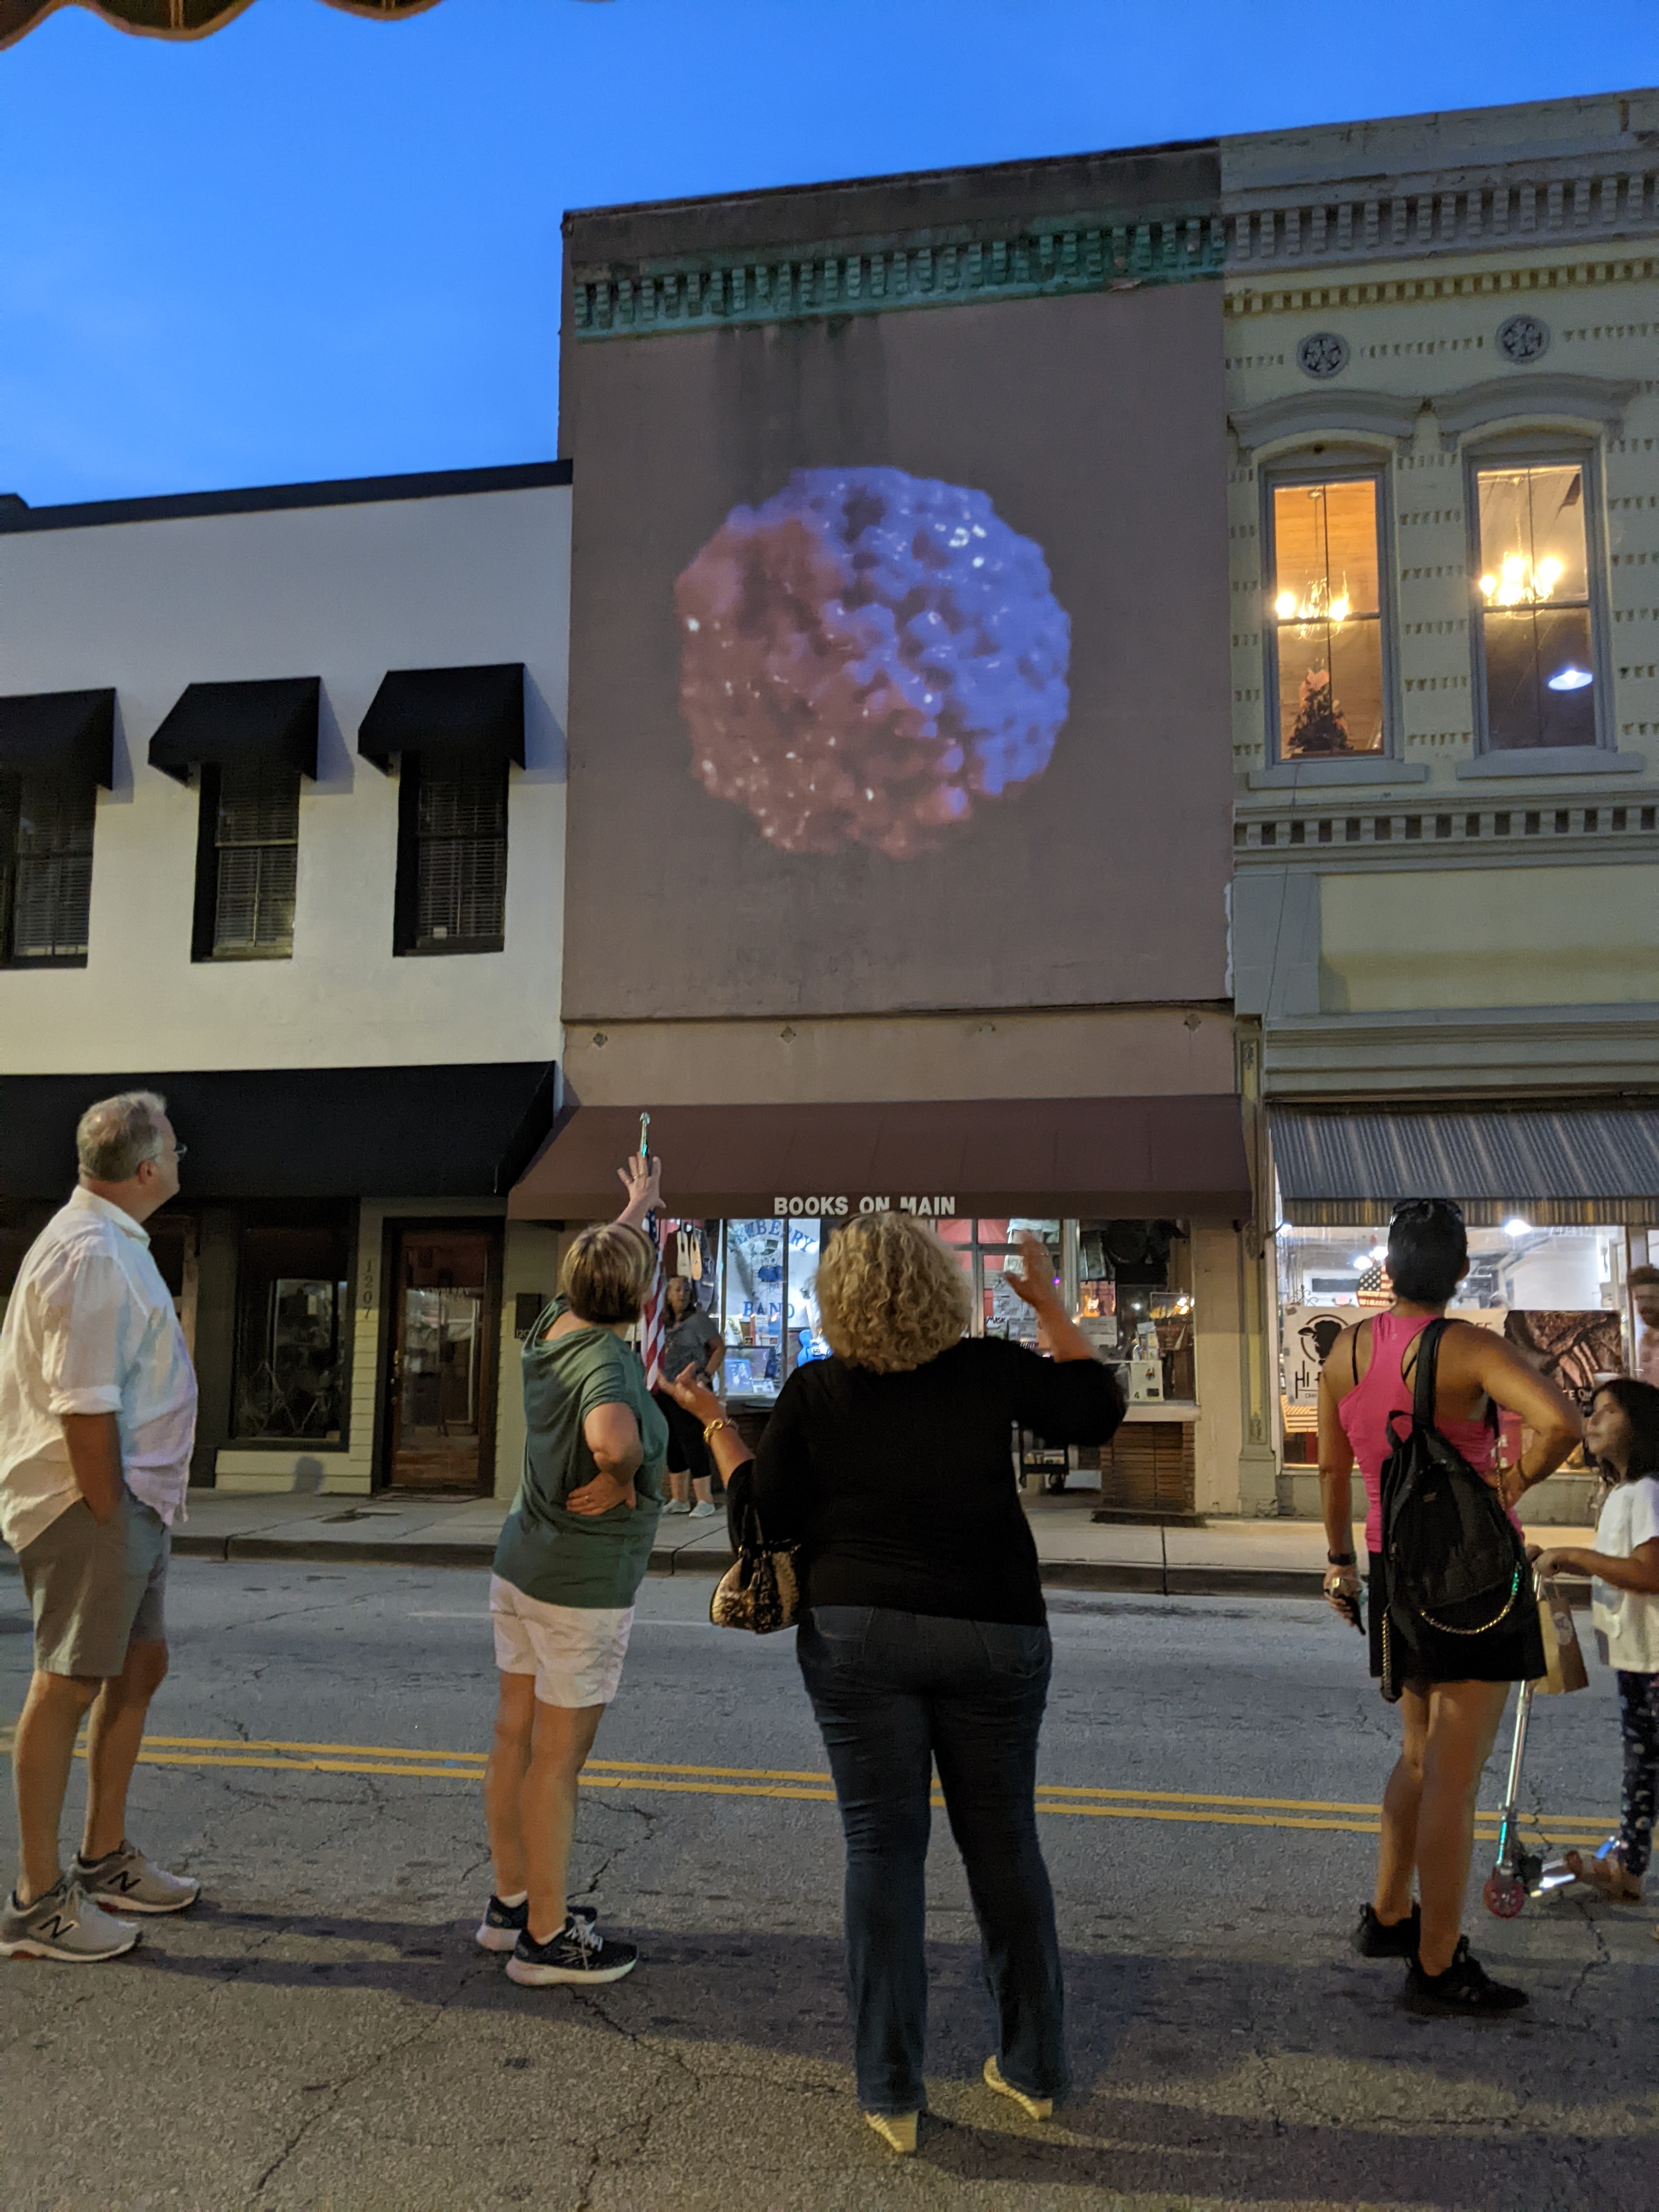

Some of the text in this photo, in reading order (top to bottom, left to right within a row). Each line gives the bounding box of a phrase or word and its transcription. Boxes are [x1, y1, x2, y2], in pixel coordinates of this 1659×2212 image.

[774, 1197, 955, 1215] BOOKS ON MAIN
[727, 1219, 816, 1253] EWBERRY
[362, 1260, 374, 1320] 1207
[743, 1301, 795, 1319] BAND
[1295, 1360, 1310, 1400] HI
